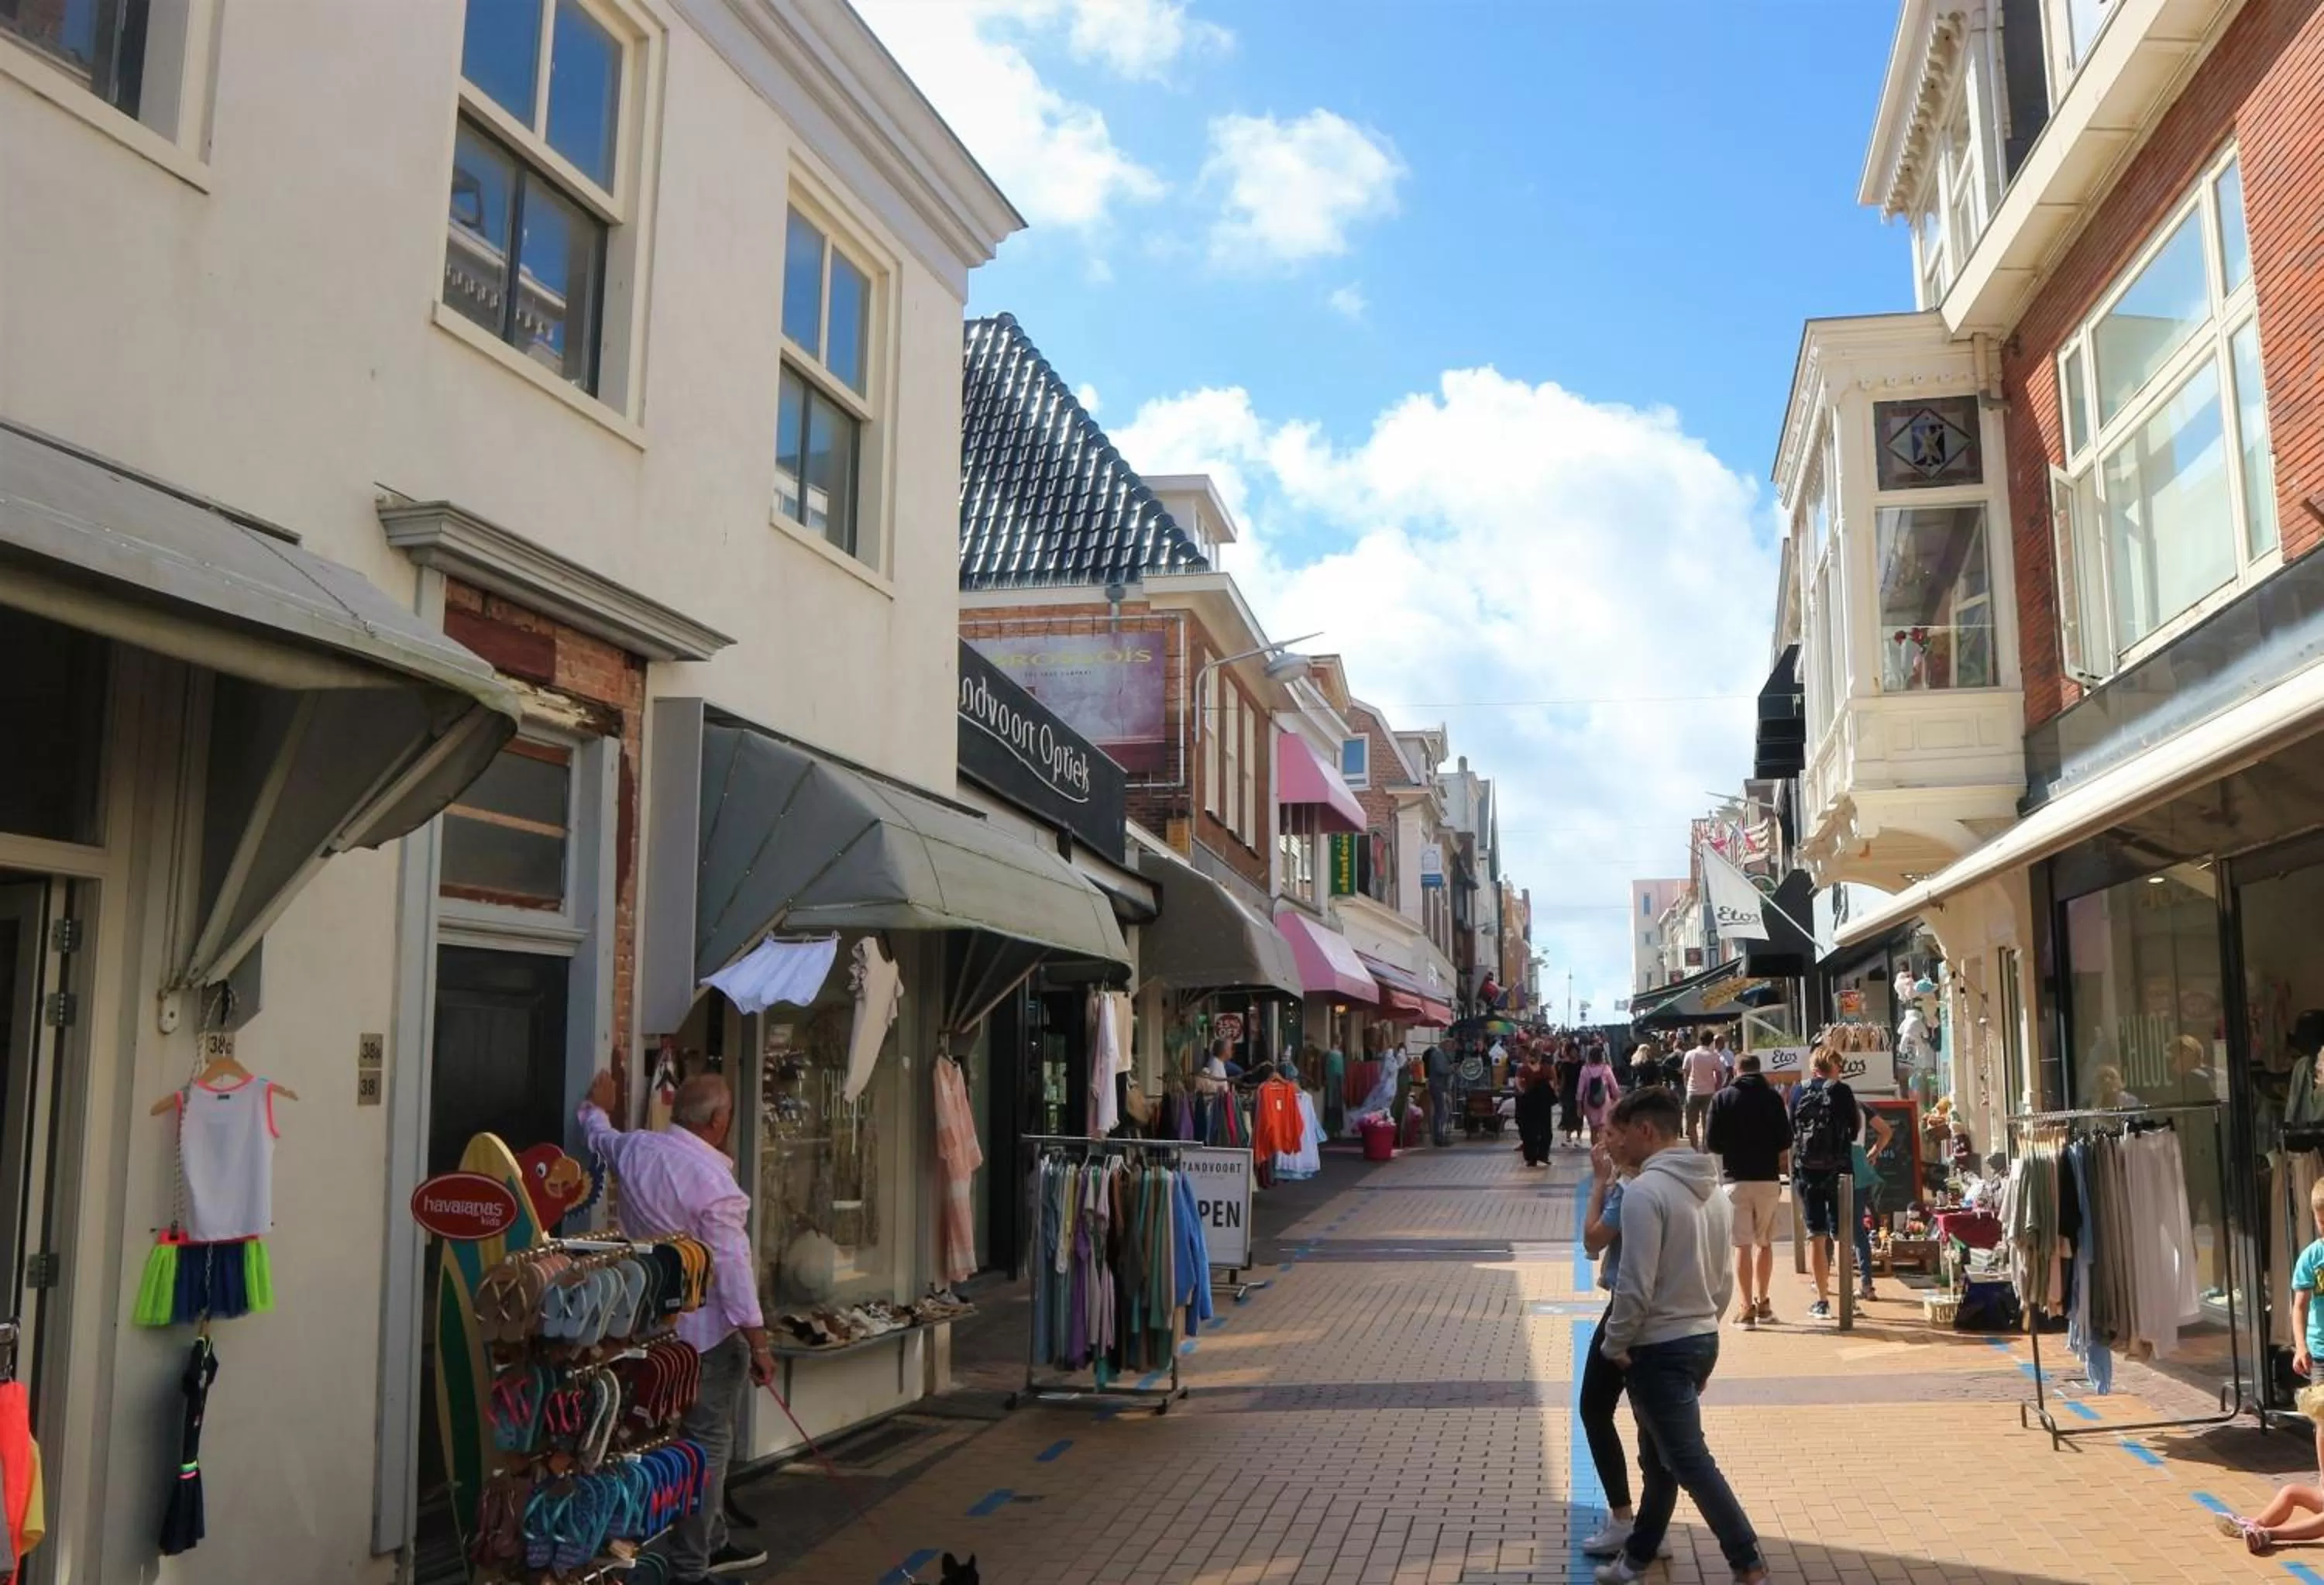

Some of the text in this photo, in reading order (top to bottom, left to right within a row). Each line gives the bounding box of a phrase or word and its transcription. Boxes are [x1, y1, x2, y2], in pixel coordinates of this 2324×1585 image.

[961, 676, 1090, 794] ndvoort Optiek
[1717, 906, 1761, 924] Etos
[1772, 1050, 1798, 1064] Etos
[1841, 1057, 1867, 1074] tos
[360, 1078, 376, 1096] 38
[424, 1194, 505, 1217] havaianas
[1197, 1199, 1241, 1228] PEN
